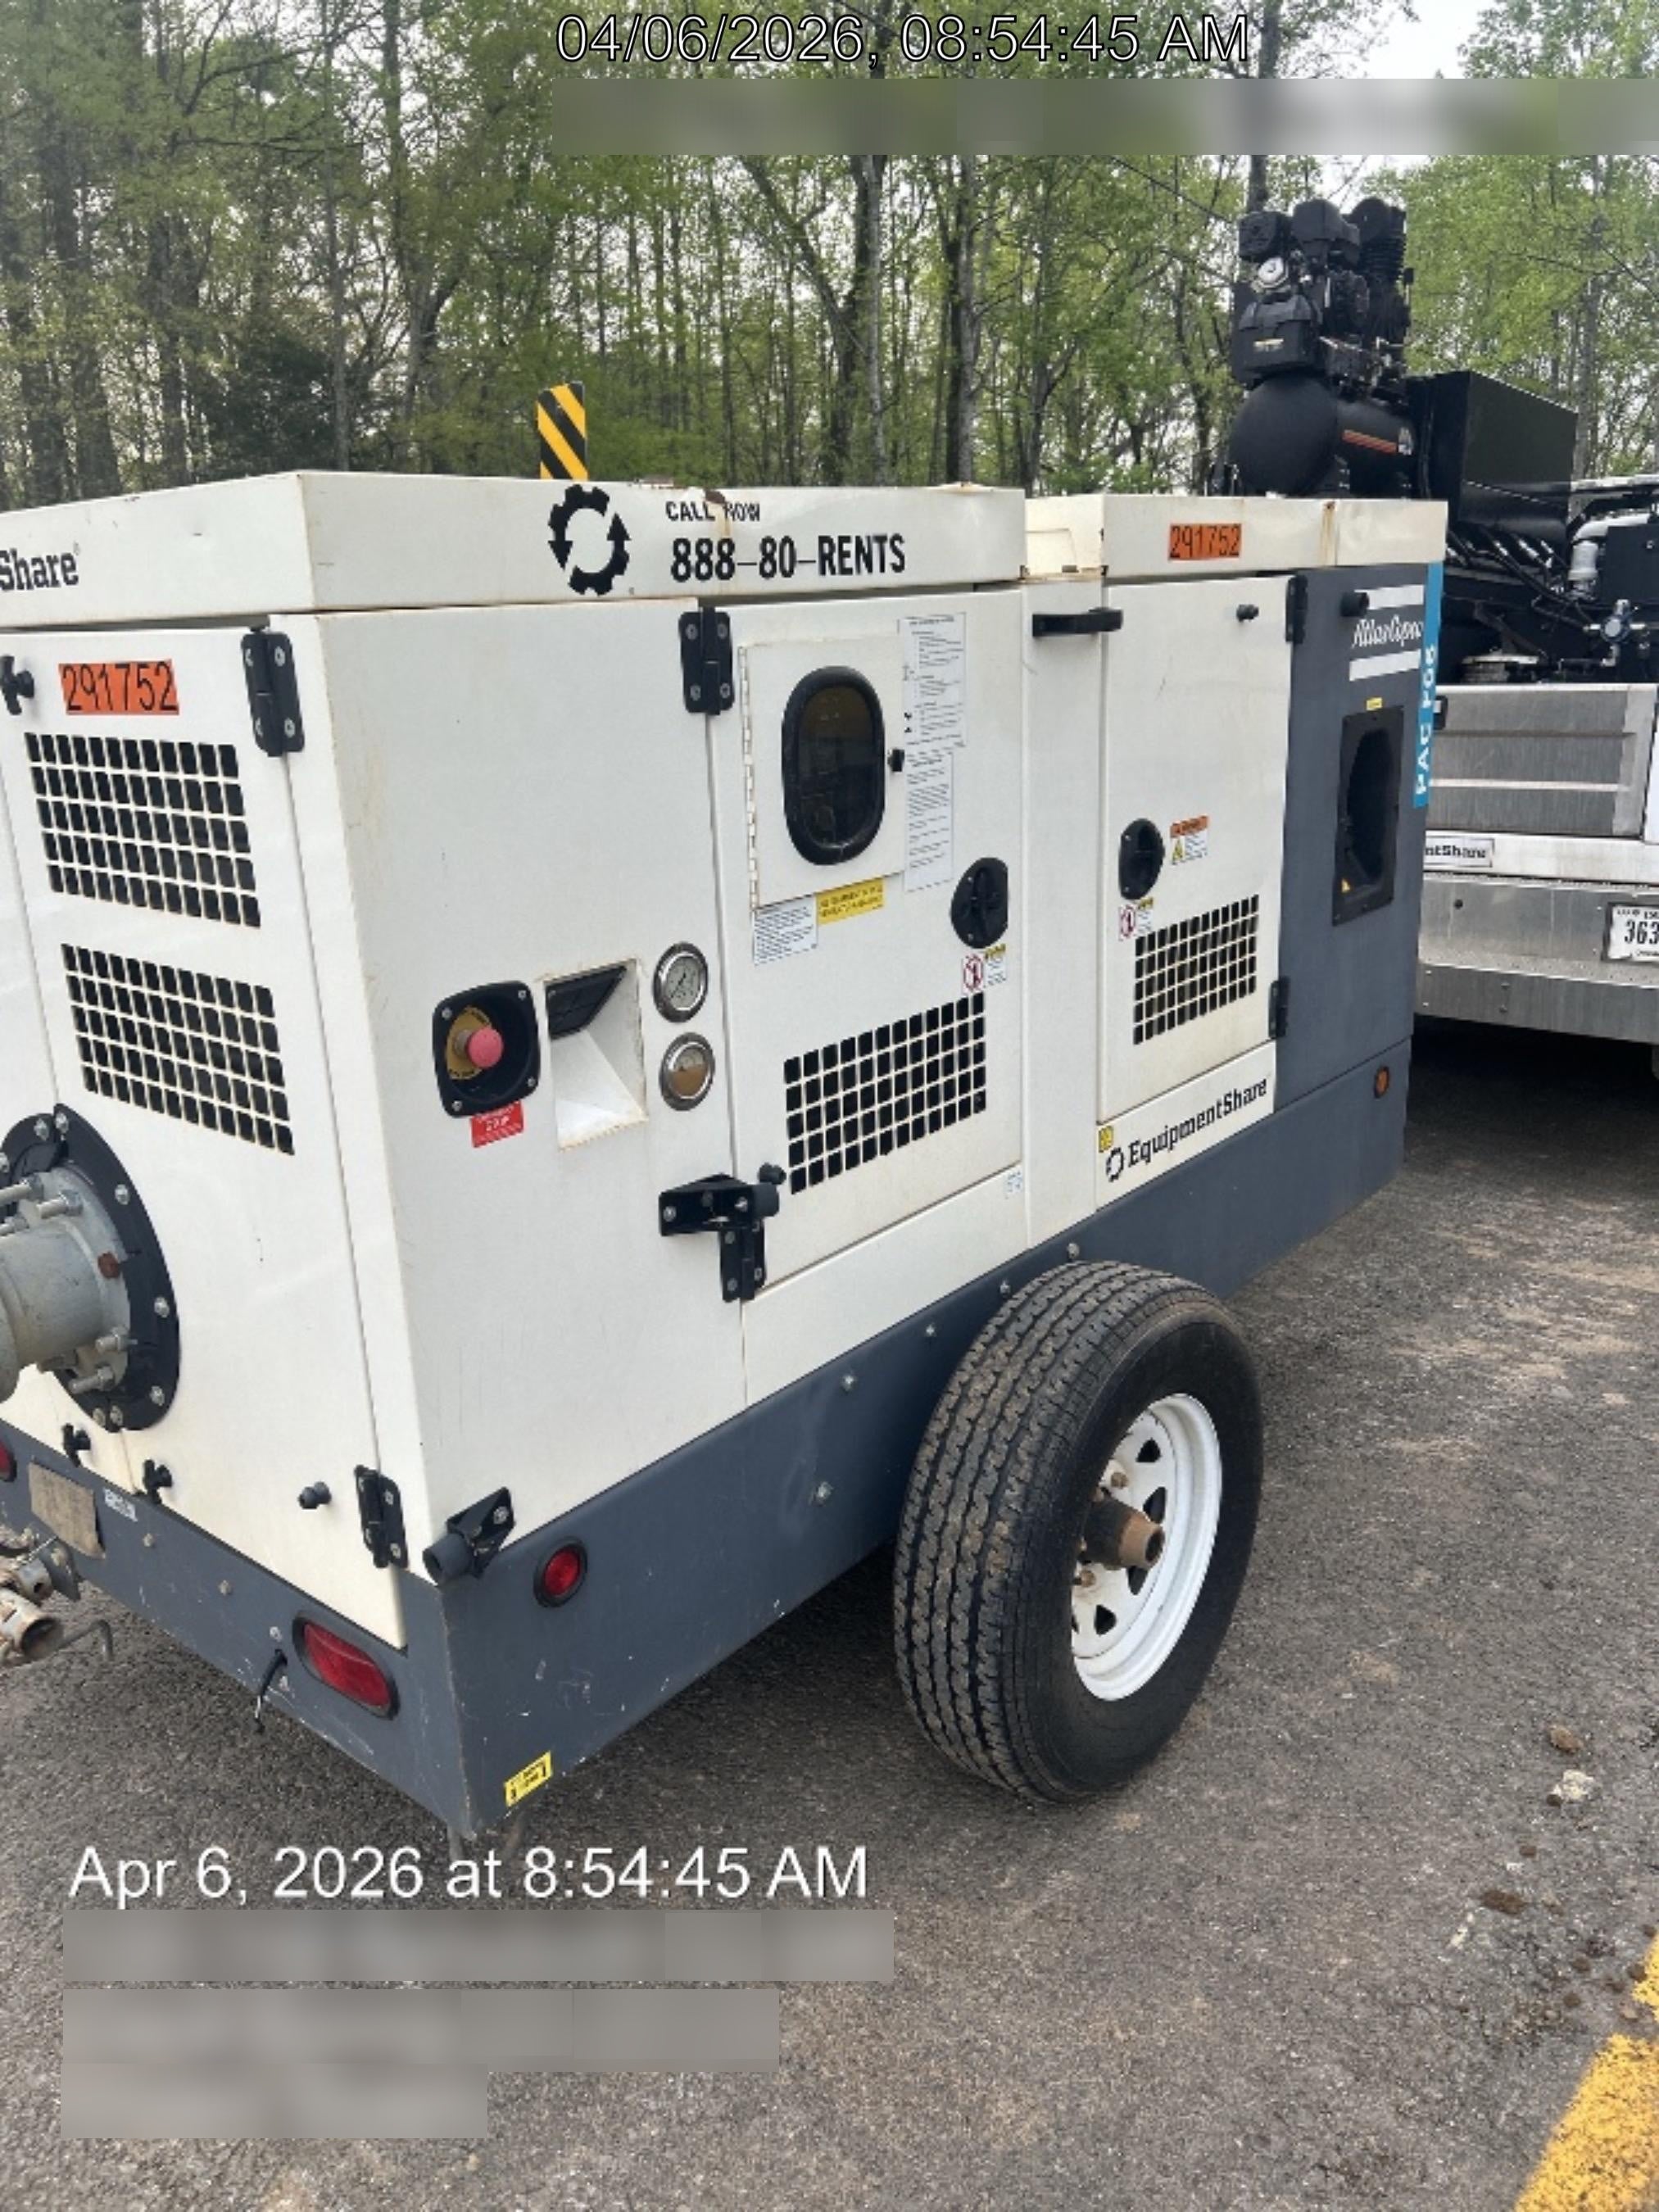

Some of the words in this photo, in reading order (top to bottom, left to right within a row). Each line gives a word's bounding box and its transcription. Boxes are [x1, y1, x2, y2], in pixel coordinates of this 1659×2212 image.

[665, 501, 715, 522] CALL
[671, 533, 906, 582] 888-80-RENTS
[1169, 524, 1240, 559] 291752
[63, 661, 178, 711] 291752
[1128, 1078, 1267, 1167] EquipmentShare
